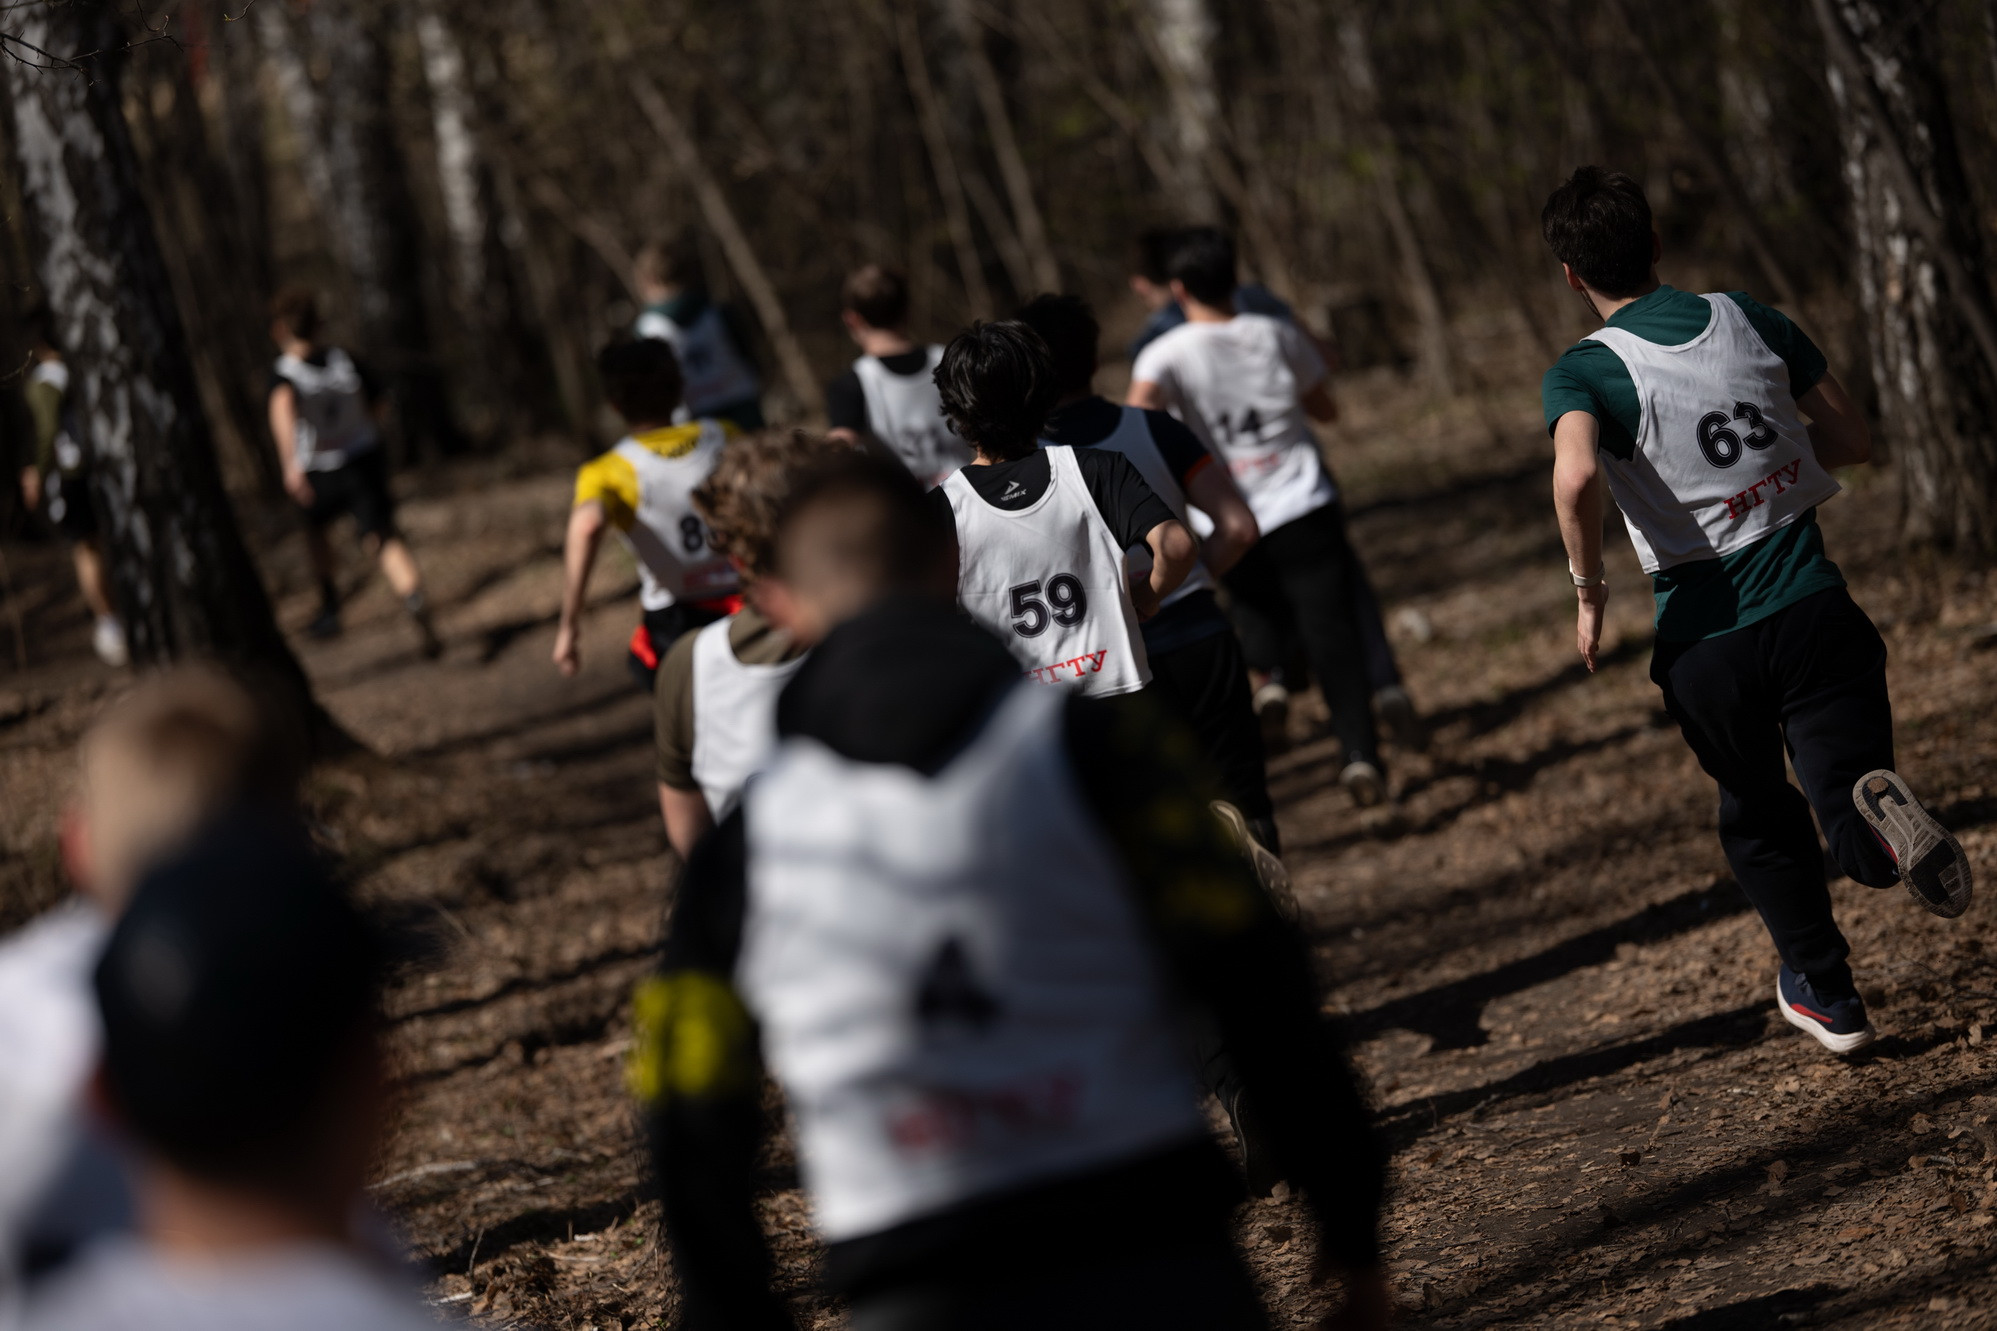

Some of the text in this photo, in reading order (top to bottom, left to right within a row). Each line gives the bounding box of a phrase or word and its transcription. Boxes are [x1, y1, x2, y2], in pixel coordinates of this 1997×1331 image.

[1696, 401, 1779, 469] 63
[1723, 458, 1801, 520] НГТУ
[1009, 573, 1087, 638] 59
